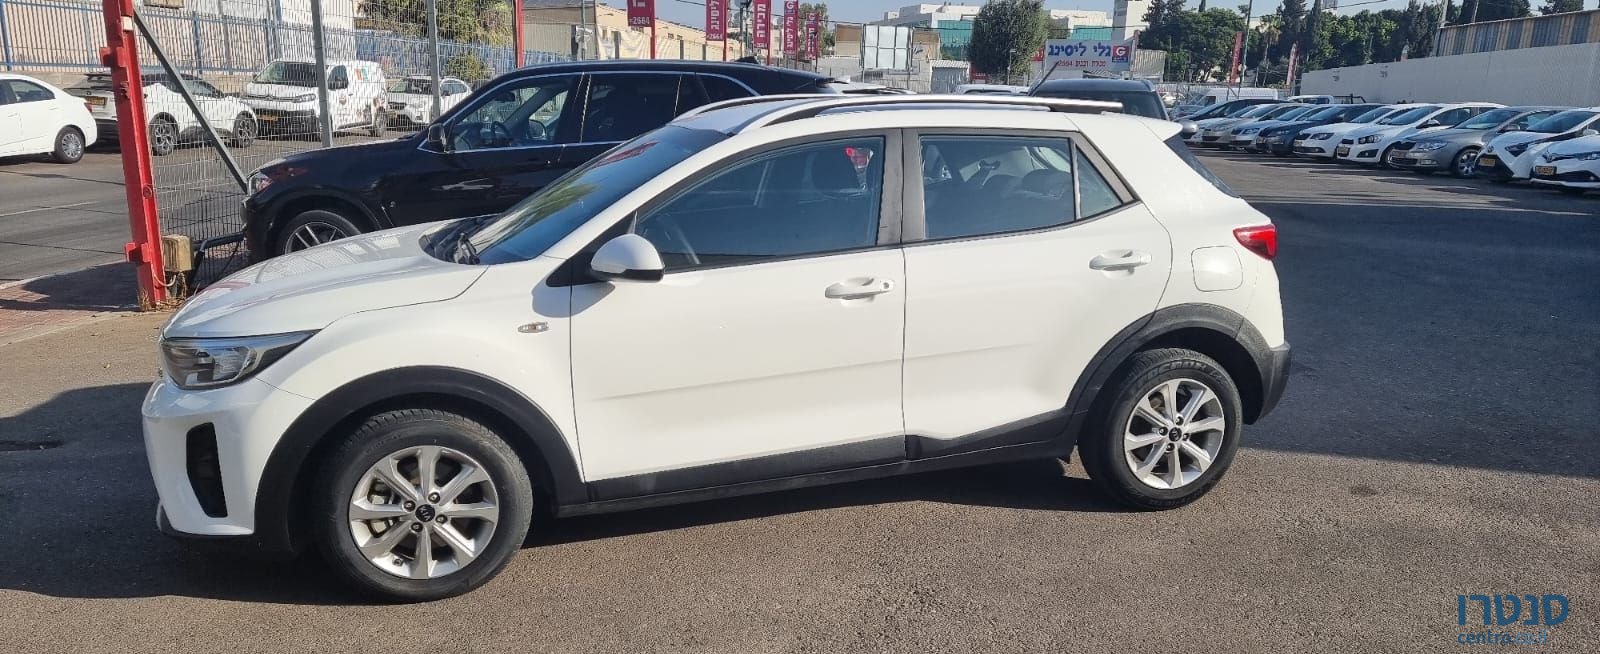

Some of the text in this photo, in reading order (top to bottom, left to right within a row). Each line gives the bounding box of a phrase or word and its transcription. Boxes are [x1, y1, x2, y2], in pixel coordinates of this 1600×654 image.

[1048, 42, 1087, 56] ליסינג
[1093, 42, 1111, 56] גלי
[1116, 46, 1126, 56] G
